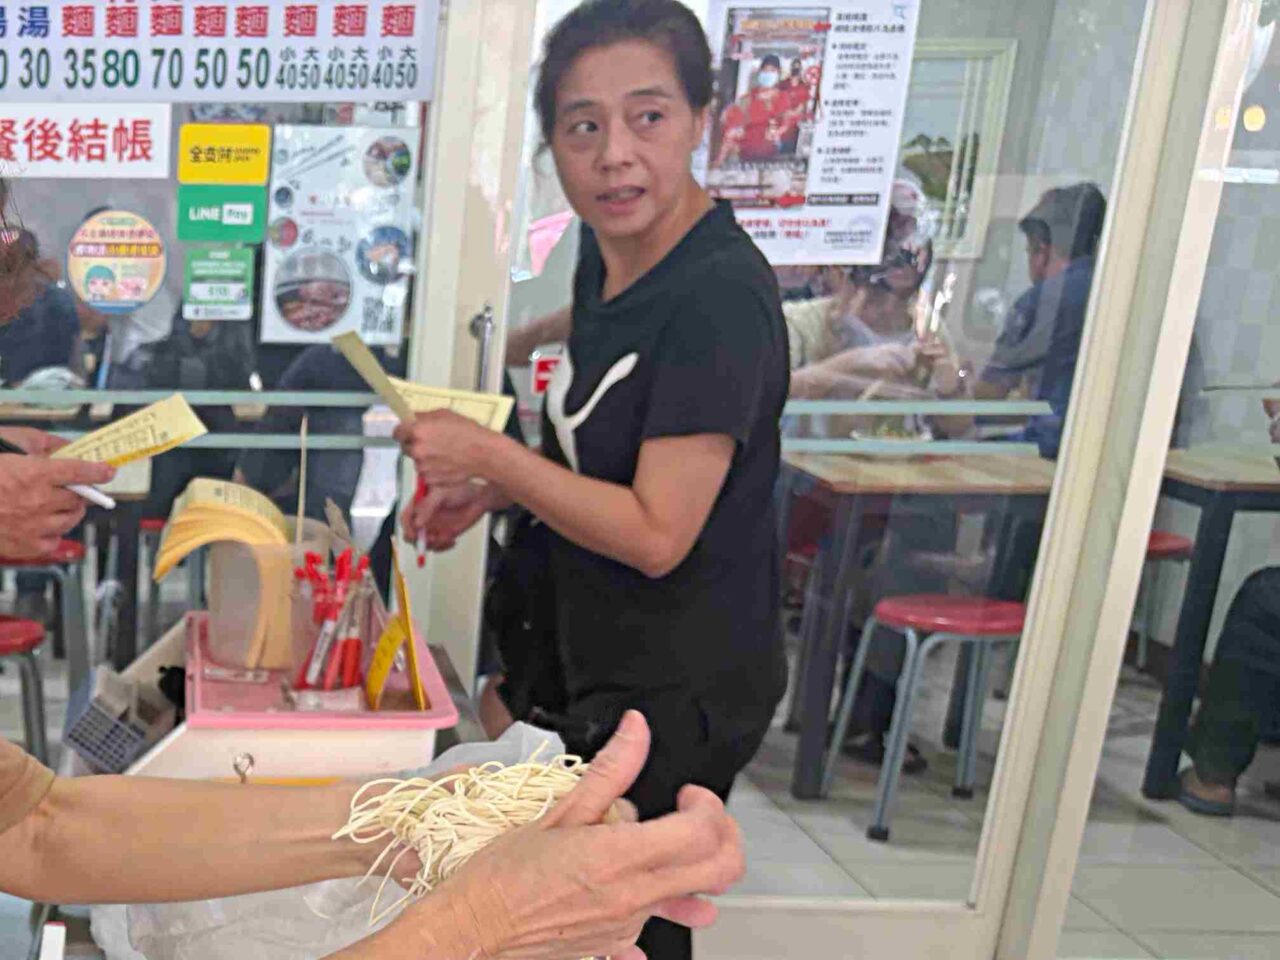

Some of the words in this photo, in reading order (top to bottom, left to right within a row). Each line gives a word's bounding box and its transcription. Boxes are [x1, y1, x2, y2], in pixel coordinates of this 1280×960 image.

[17, 6, 50, 38] 湯
[62, 5, 95, 38] 麵
[105, 5, 139, 38] 麵
[151, 5, 184, 38] 麵
[194, 5, 227, 38] 麵
[235, 5, 269, 38] 麵
[283, 5, 318, 38] 麵
[332, 5, 368, 38] 麵
[381, 5, 416, 38] 麵
[19, 48, 51, 89] 30
[64, 49, 97, 89] 35
[103, 49, 139, 87] 80
[151, 48, 184, 89] 70
[194, 48, 228, 89] 50
[236, 47, 269, 89] 50
[275, 63, 296, 90] 40
[298, 63, 319, 90] 50
[323, 63, 345, 90] 40
[347, 63, 368, 90] 50
[371, 63, 393, 90] 40
[394, 63, 417, 90] 50
[189, 206, 220, 221] LINE
